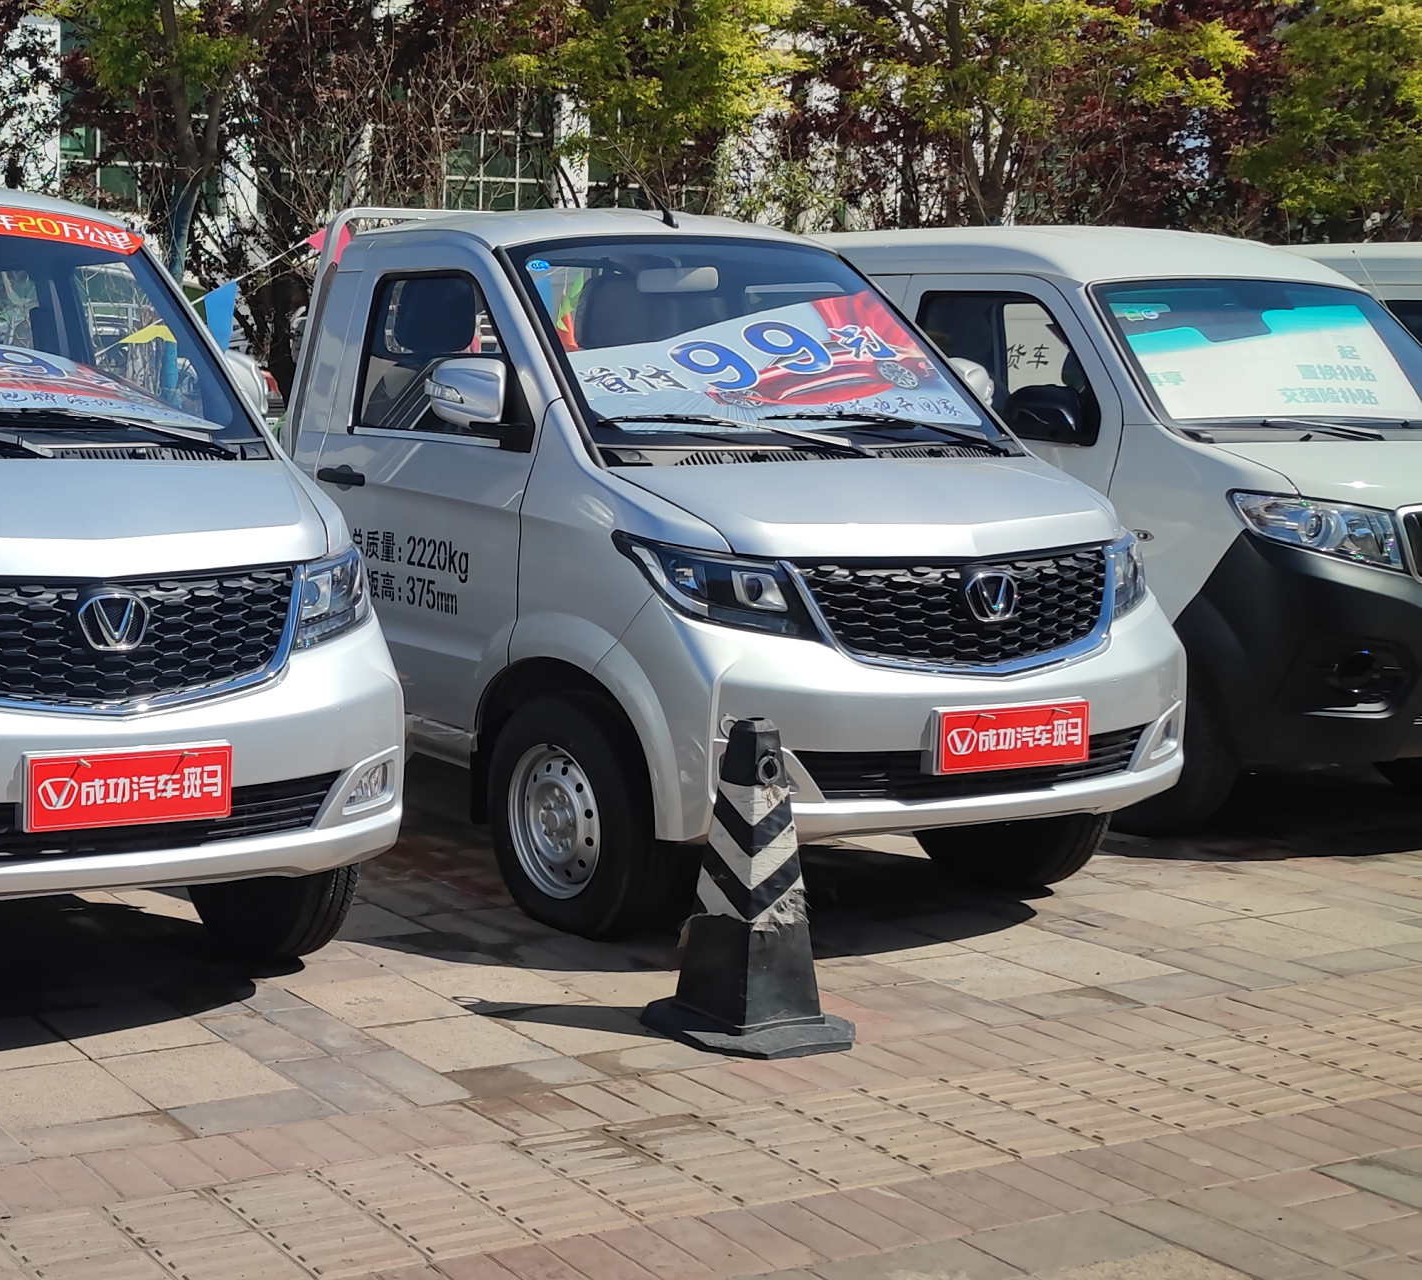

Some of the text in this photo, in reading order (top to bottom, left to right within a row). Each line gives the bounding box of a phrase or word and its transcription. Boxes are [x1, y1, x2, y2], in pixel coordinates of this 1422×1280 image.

[1007, 343, 1049, 370] 货车
[1277, 387, 1379, 405] 交强险补贴
[80, 764, 222, 806] 成功汽车斑马
